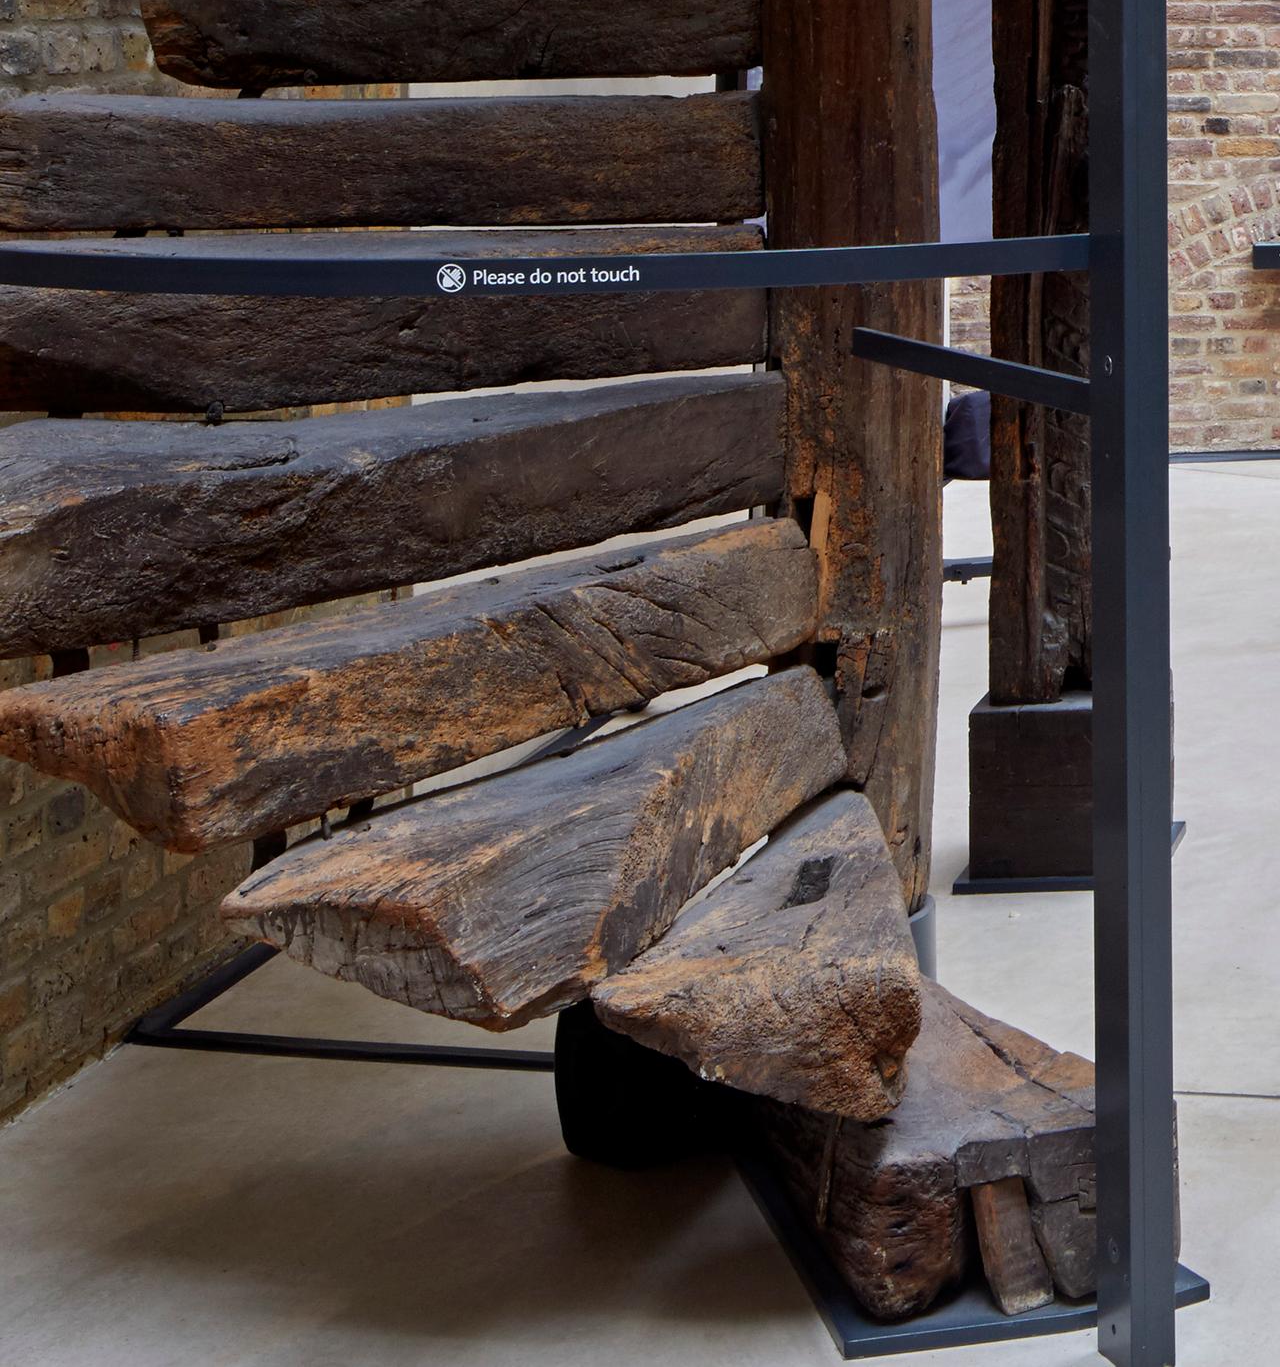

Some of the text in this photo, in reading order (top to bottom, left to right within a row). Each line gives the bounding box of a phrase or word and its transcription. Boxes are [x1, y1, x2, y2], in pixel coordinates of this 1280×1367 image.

[473, 266, 640, 285] Please do not touch
